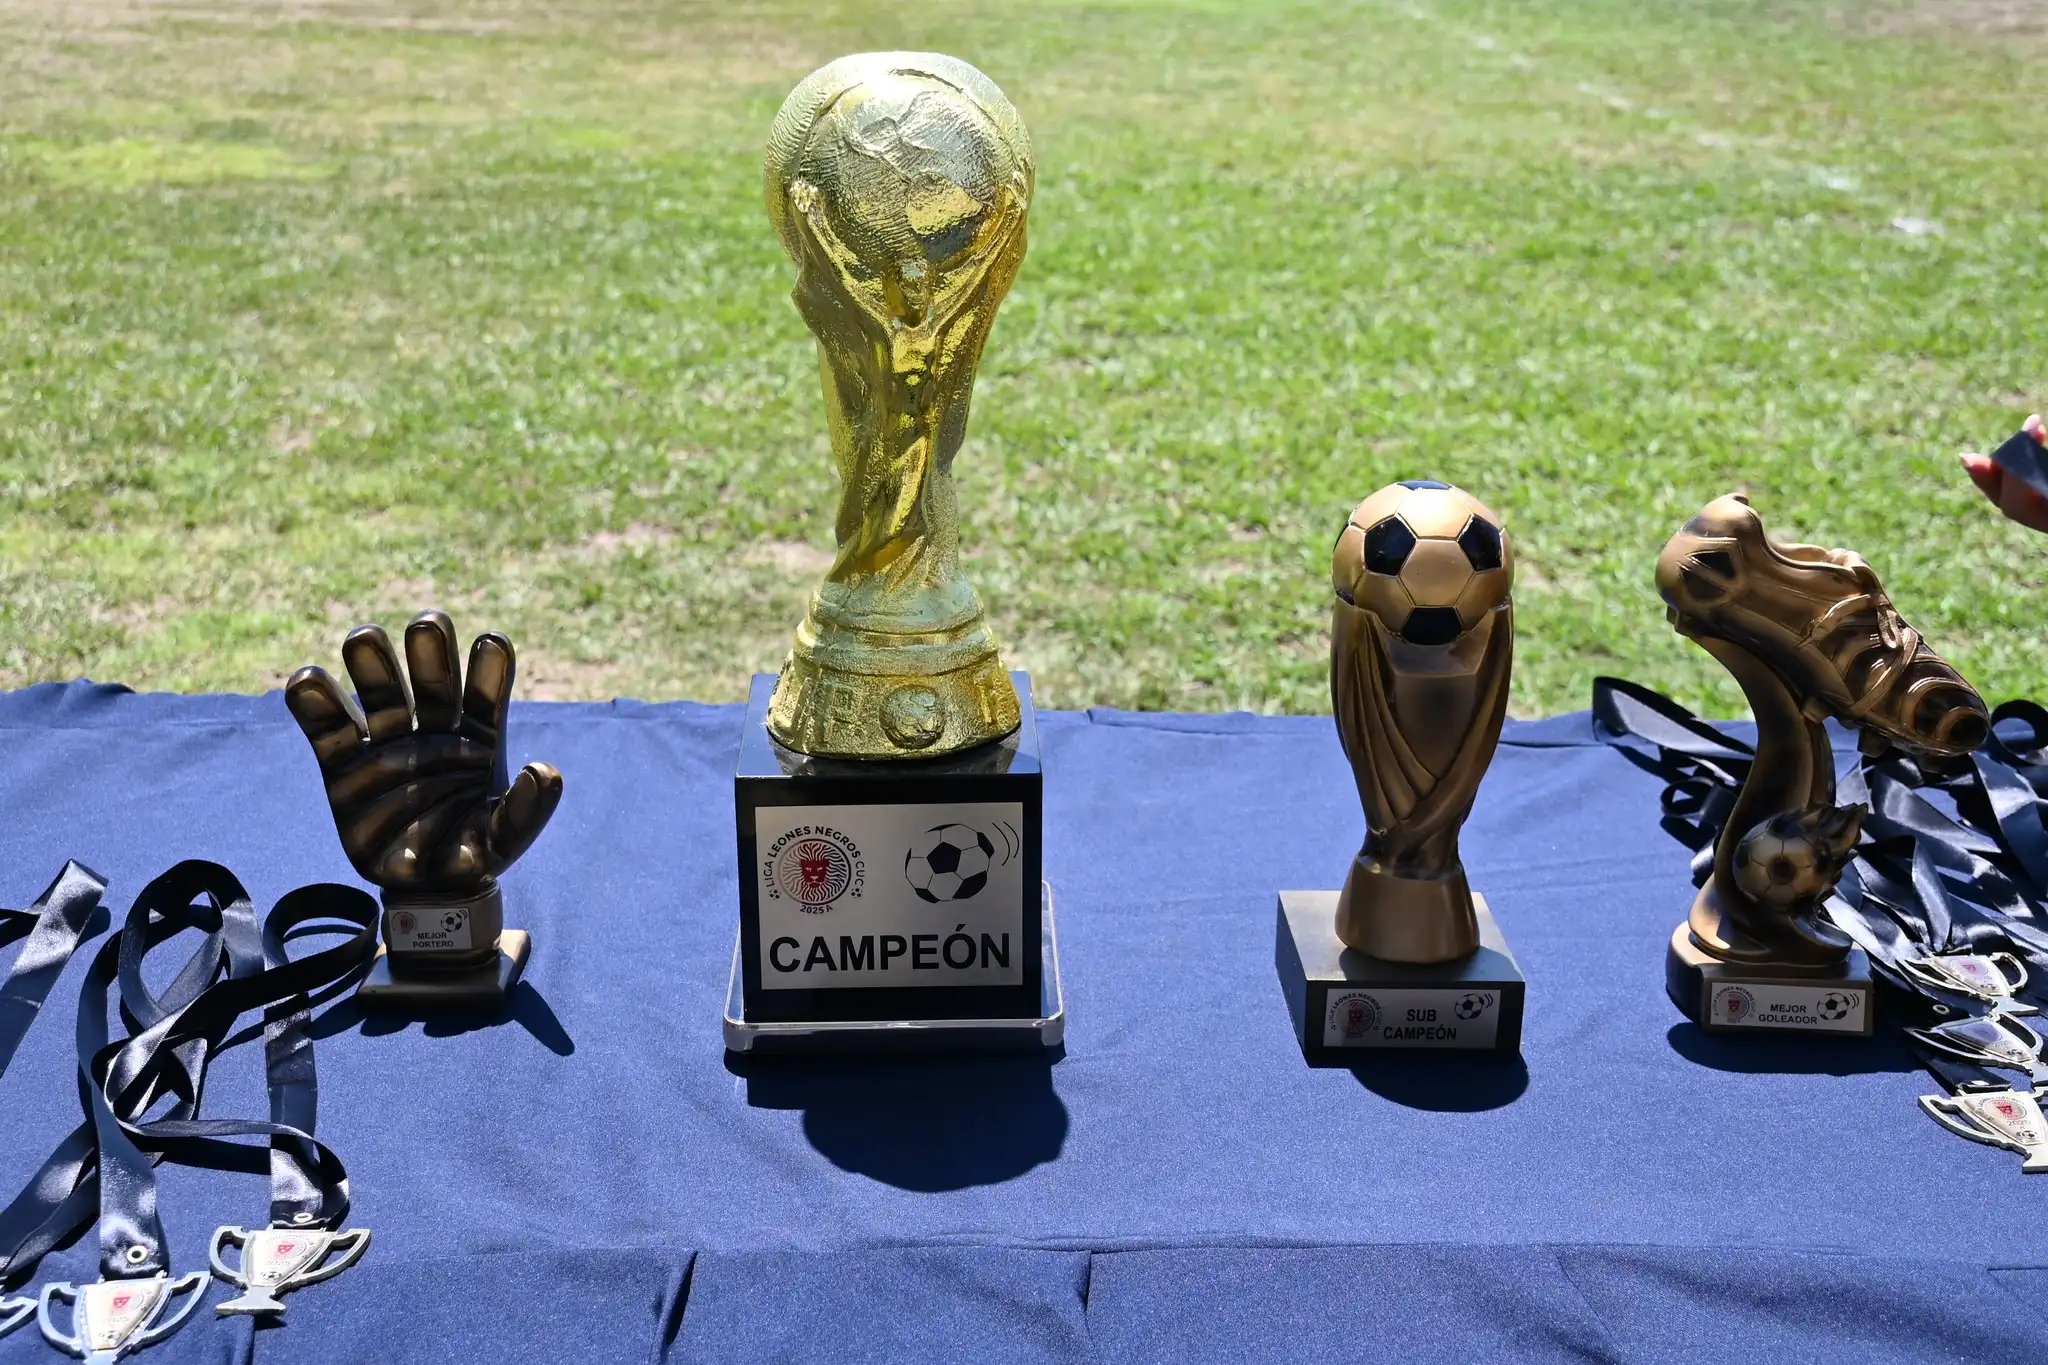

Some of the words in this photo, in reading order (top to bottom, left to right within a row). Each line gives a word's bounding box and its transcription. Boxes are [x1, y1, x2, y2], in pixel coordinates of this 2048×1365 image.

[767, 825, 812, 858] LEONES
[814, 825, 861, 859] NEGROS
[763, 860, 775, 888] LIGA
[854, 861, 866, 887] CUC
[799, 904, 825, 915] 2025
[825, 904, 834, 913] A
[412, 940, 454, 948] PORTERO
[417, 932, 447, 940] MEJOR
[769, 924, 1010, 973] CAMPEÓN
[1406, 1008, 1437, 1022] SUB
[1770, 1003, 1807, 1014] MEJOR
[1758, 1014, 1818, 1026] GOLEADOR
[1383, 1023, 1457, 1041] CAMPEÓN
